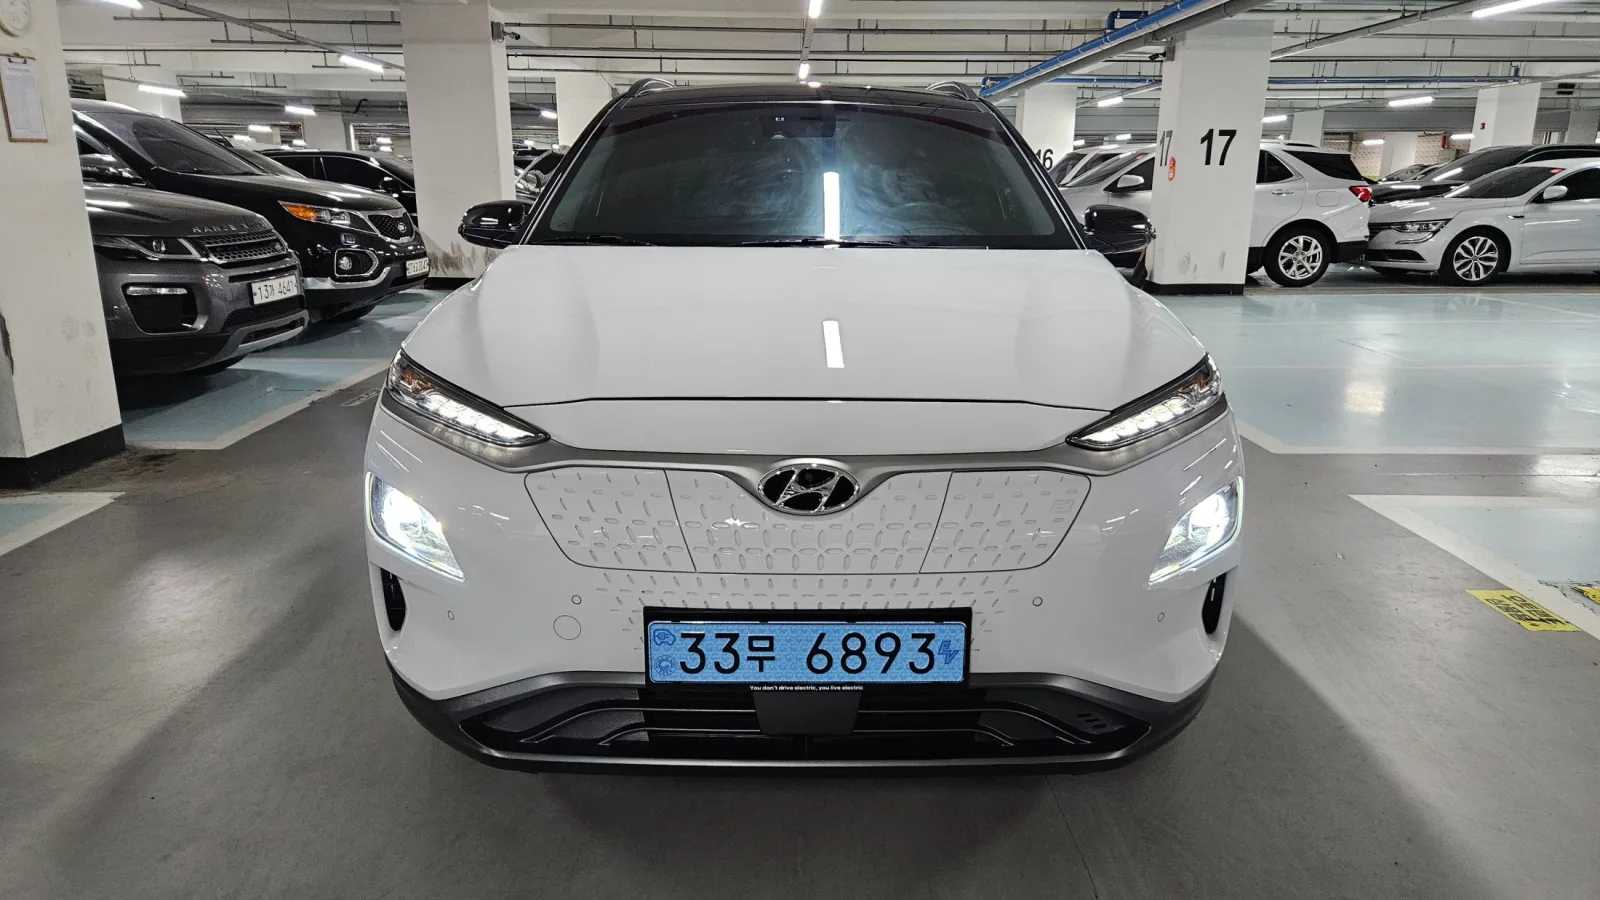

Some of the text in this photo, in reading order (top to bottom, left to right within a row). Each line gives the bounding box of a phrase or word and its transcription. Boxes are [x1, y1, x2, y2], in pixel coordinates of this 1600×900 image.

[1160, 130, 1173, 166] 17
[1200, 128, 1237, 166] 17
[679, 632, 776, 675] 33무
[806, 632, 936, 675] 6893
[937, 640, 960, 665] EV
